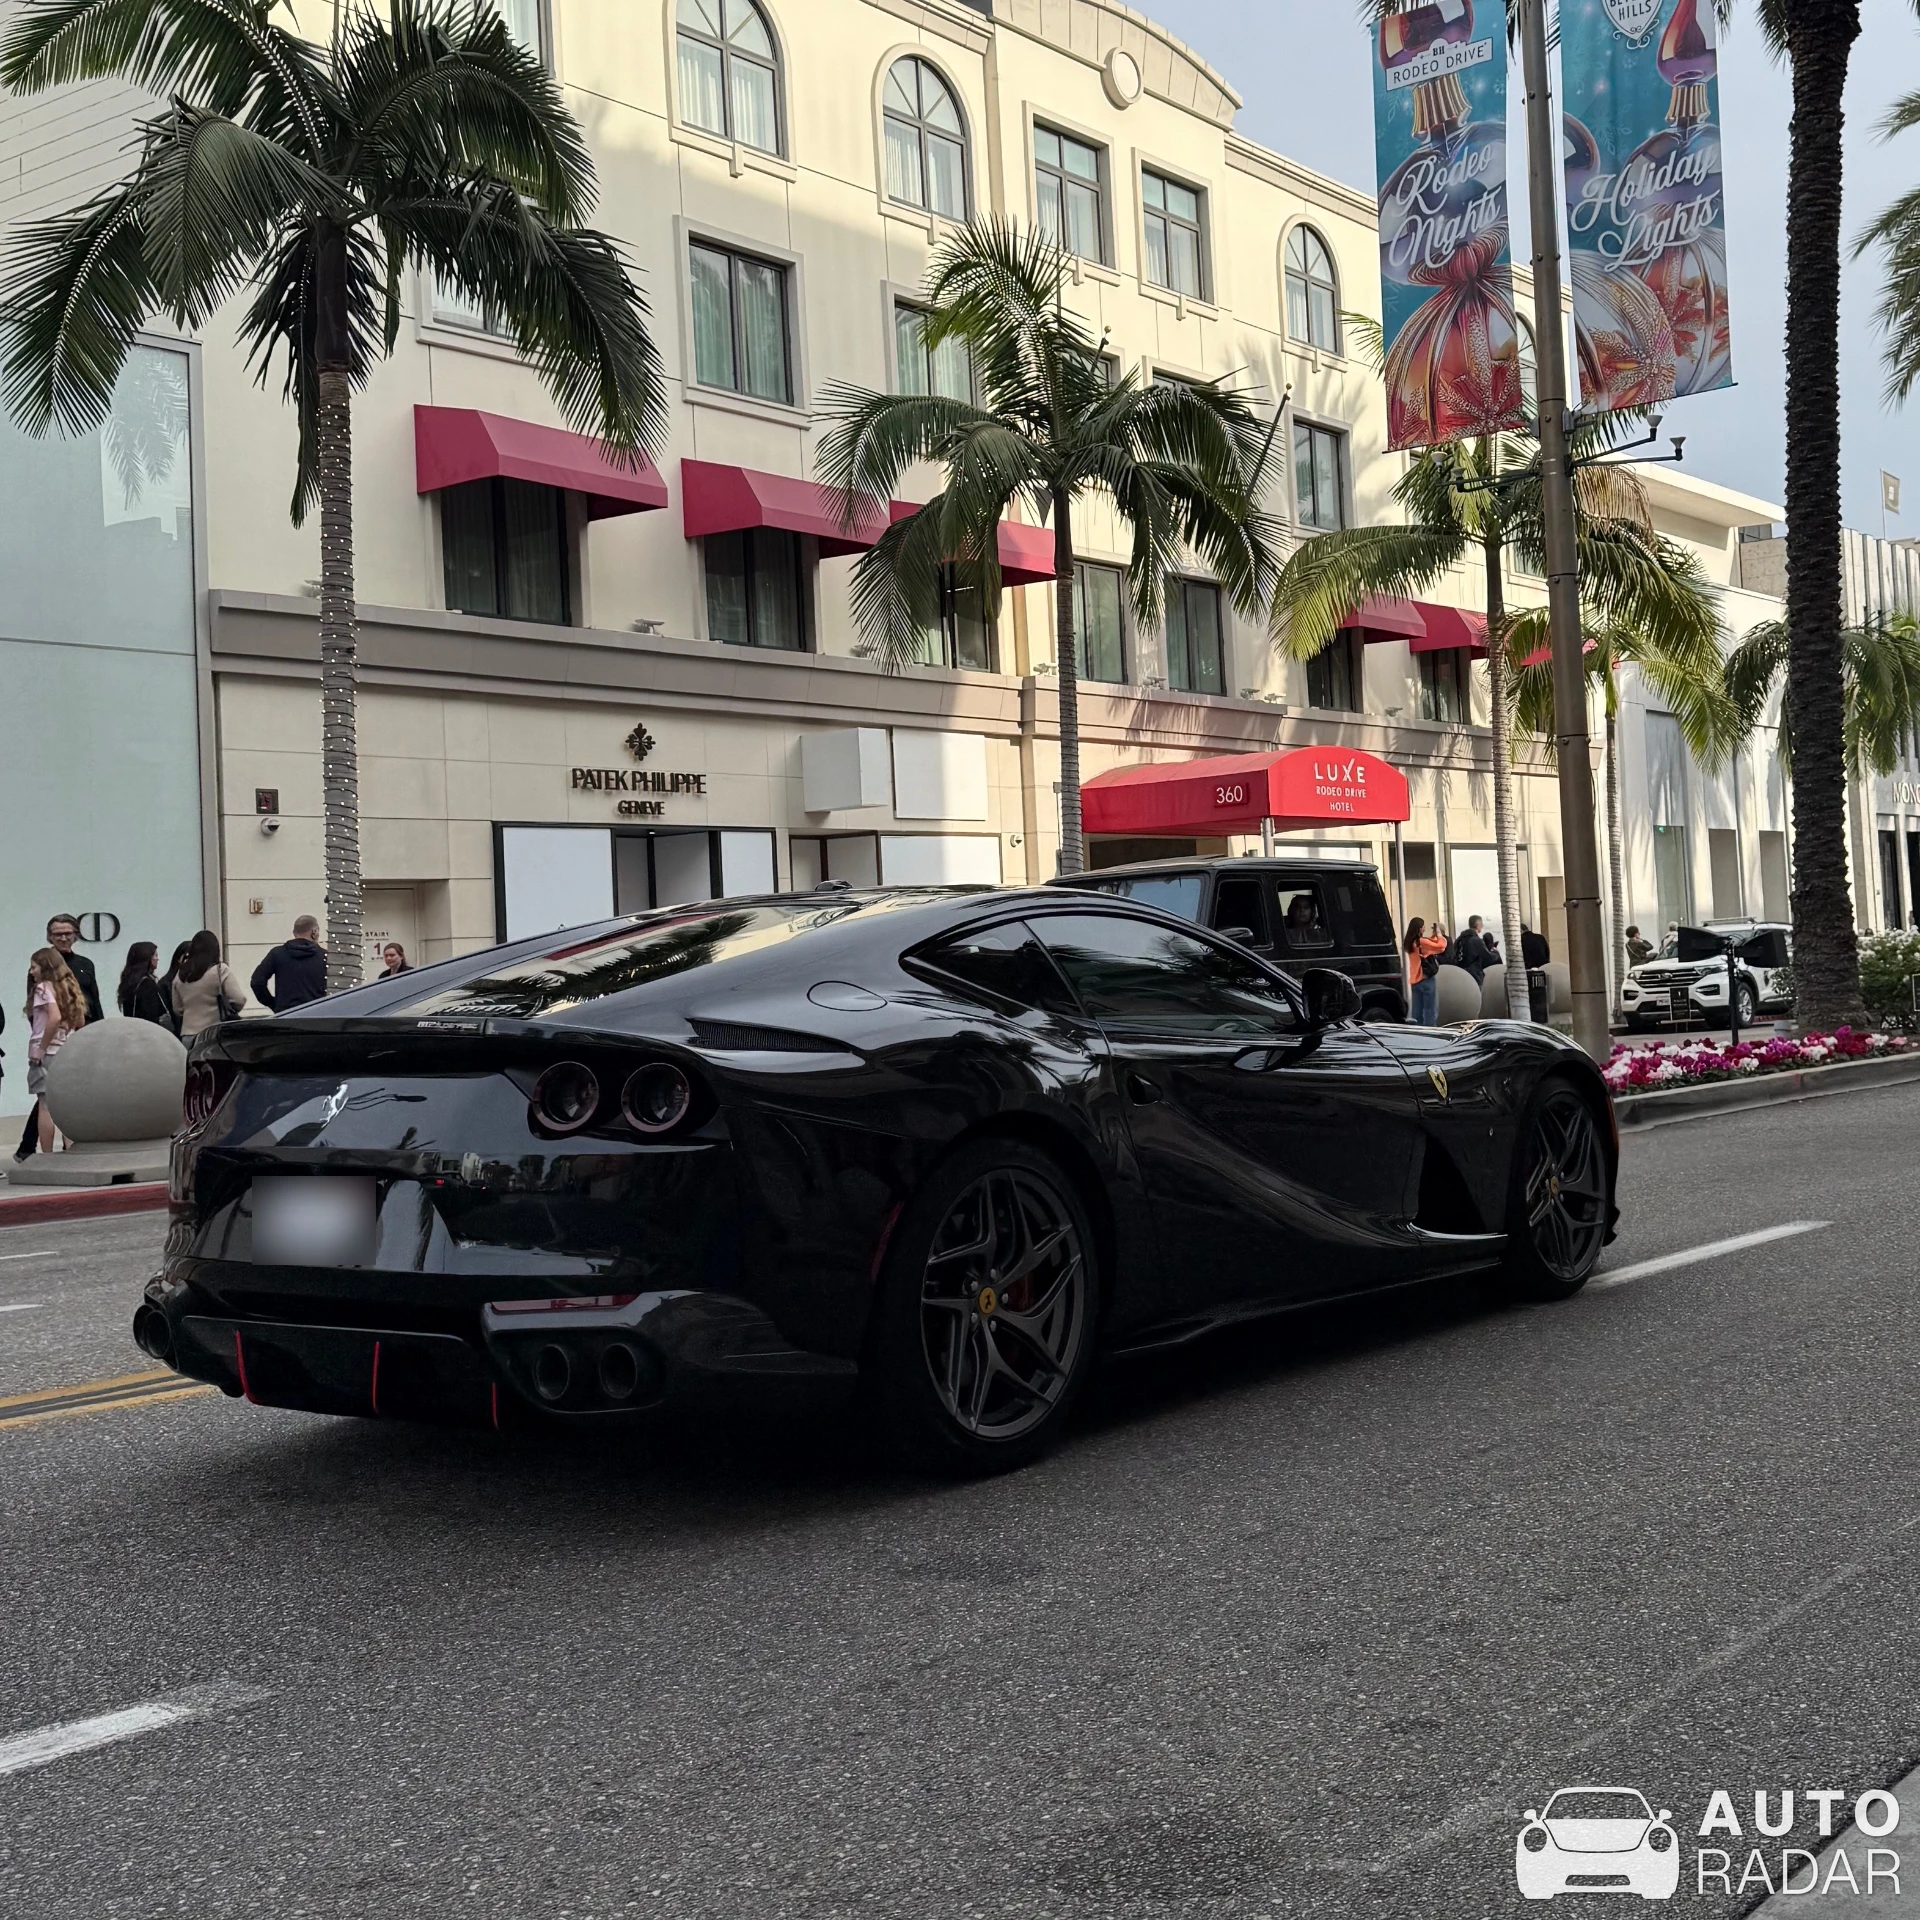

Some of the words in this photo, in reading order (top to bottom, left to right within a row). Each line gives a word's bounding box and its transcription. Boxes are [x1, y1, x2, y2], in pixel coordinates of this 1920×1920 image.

[1618, 0, 1652, 20] HILLS
[1432, 45, 1445, 57] BH
[1393, 60, 1439, 84] RODEO
[1446, 45, 1485, 69] DRIVE
[1394, 144, 1491, 217] Rodeo
[1571, 145, 1717, 232] Holiday
[1389, 186, 1502, 268] Nights
[1598, 189, 1720, 273] Lights
[571, 768, 629, 791] PATEK
[631, 770, 707, 794] PHILIPPE
[1314, 758, 1366, 783] LUXE
[1216, 785, 1243, 804] 360
[1316, 785, 1342, 797] RODEO
[1345, 787, 1367, 798] DRIVE
[617, 800, 666, 815] GENEVE
[1330, 801, 1355, 812] HOTEL
[374, 942, 381, 955] 1
